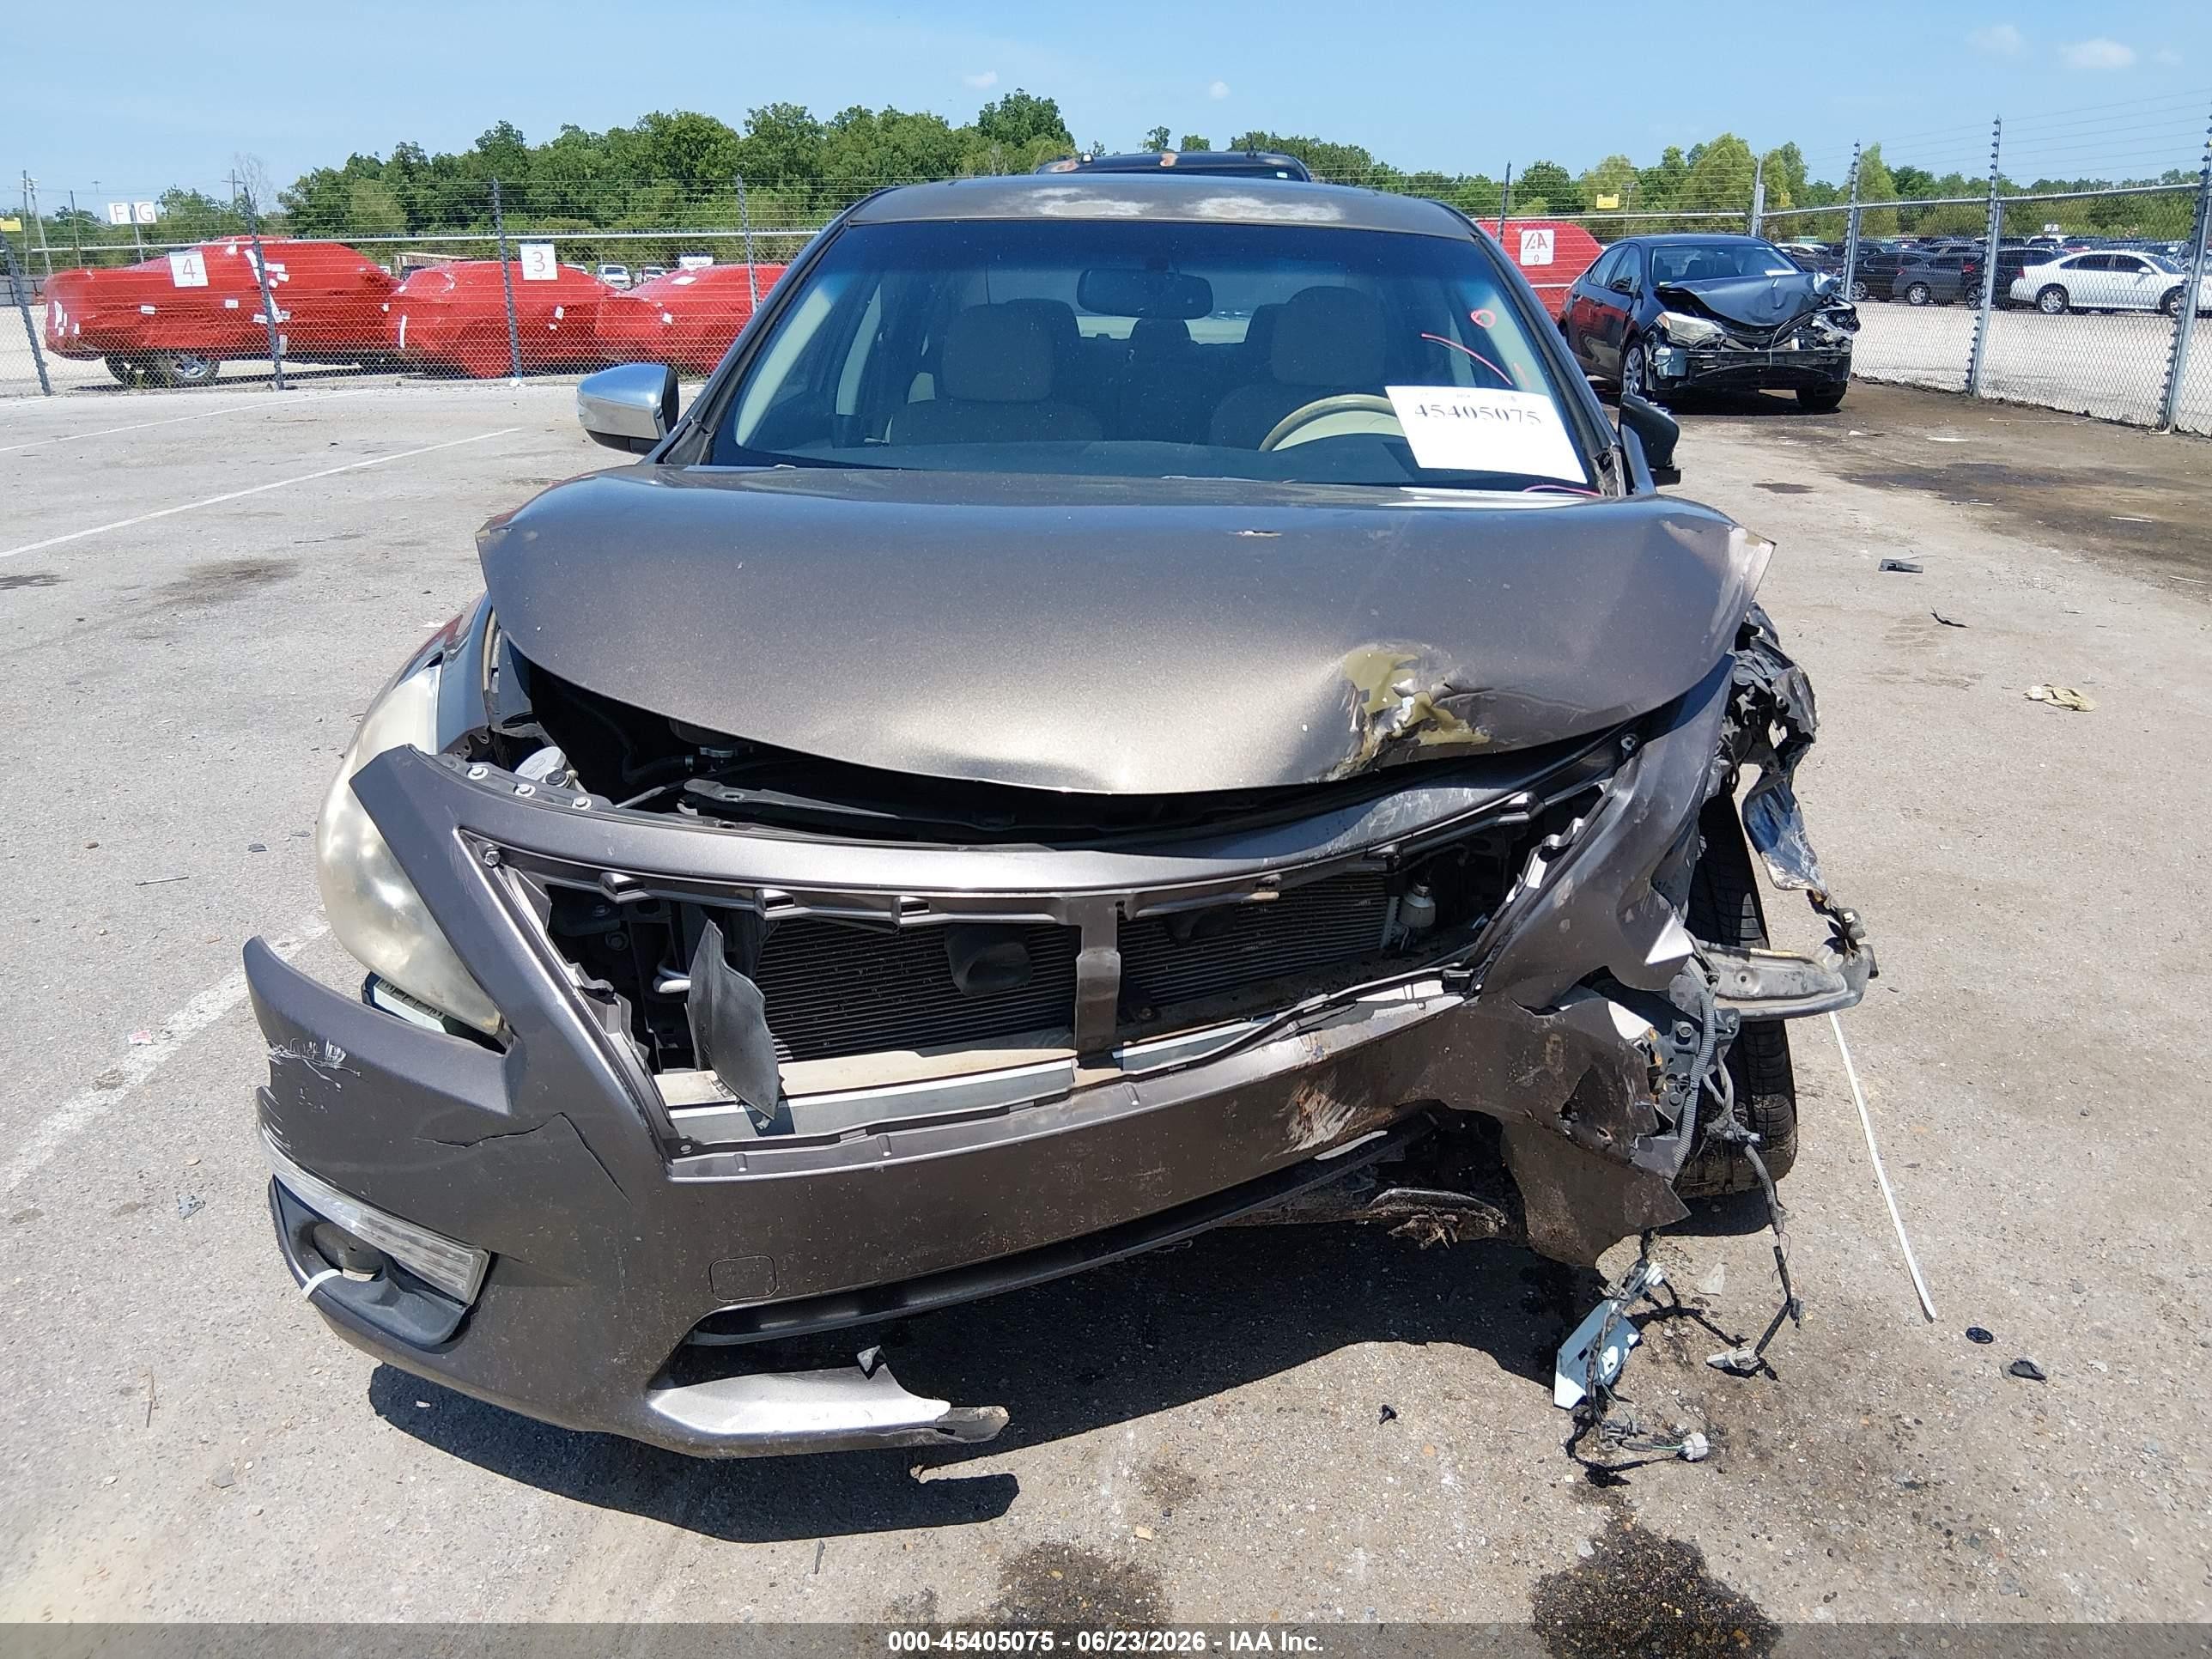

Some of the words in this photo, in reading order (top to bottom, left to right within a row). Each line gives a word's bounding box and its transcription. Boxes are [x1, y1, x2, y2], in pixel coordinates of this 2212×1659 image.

[113, 204, 125, 223] F
[138, 203, 154, 222] G
[182, 258, 197, 280] 4
[532, 251, 546, 272] 3
[1414, 404, 1541, 425] 45405075
